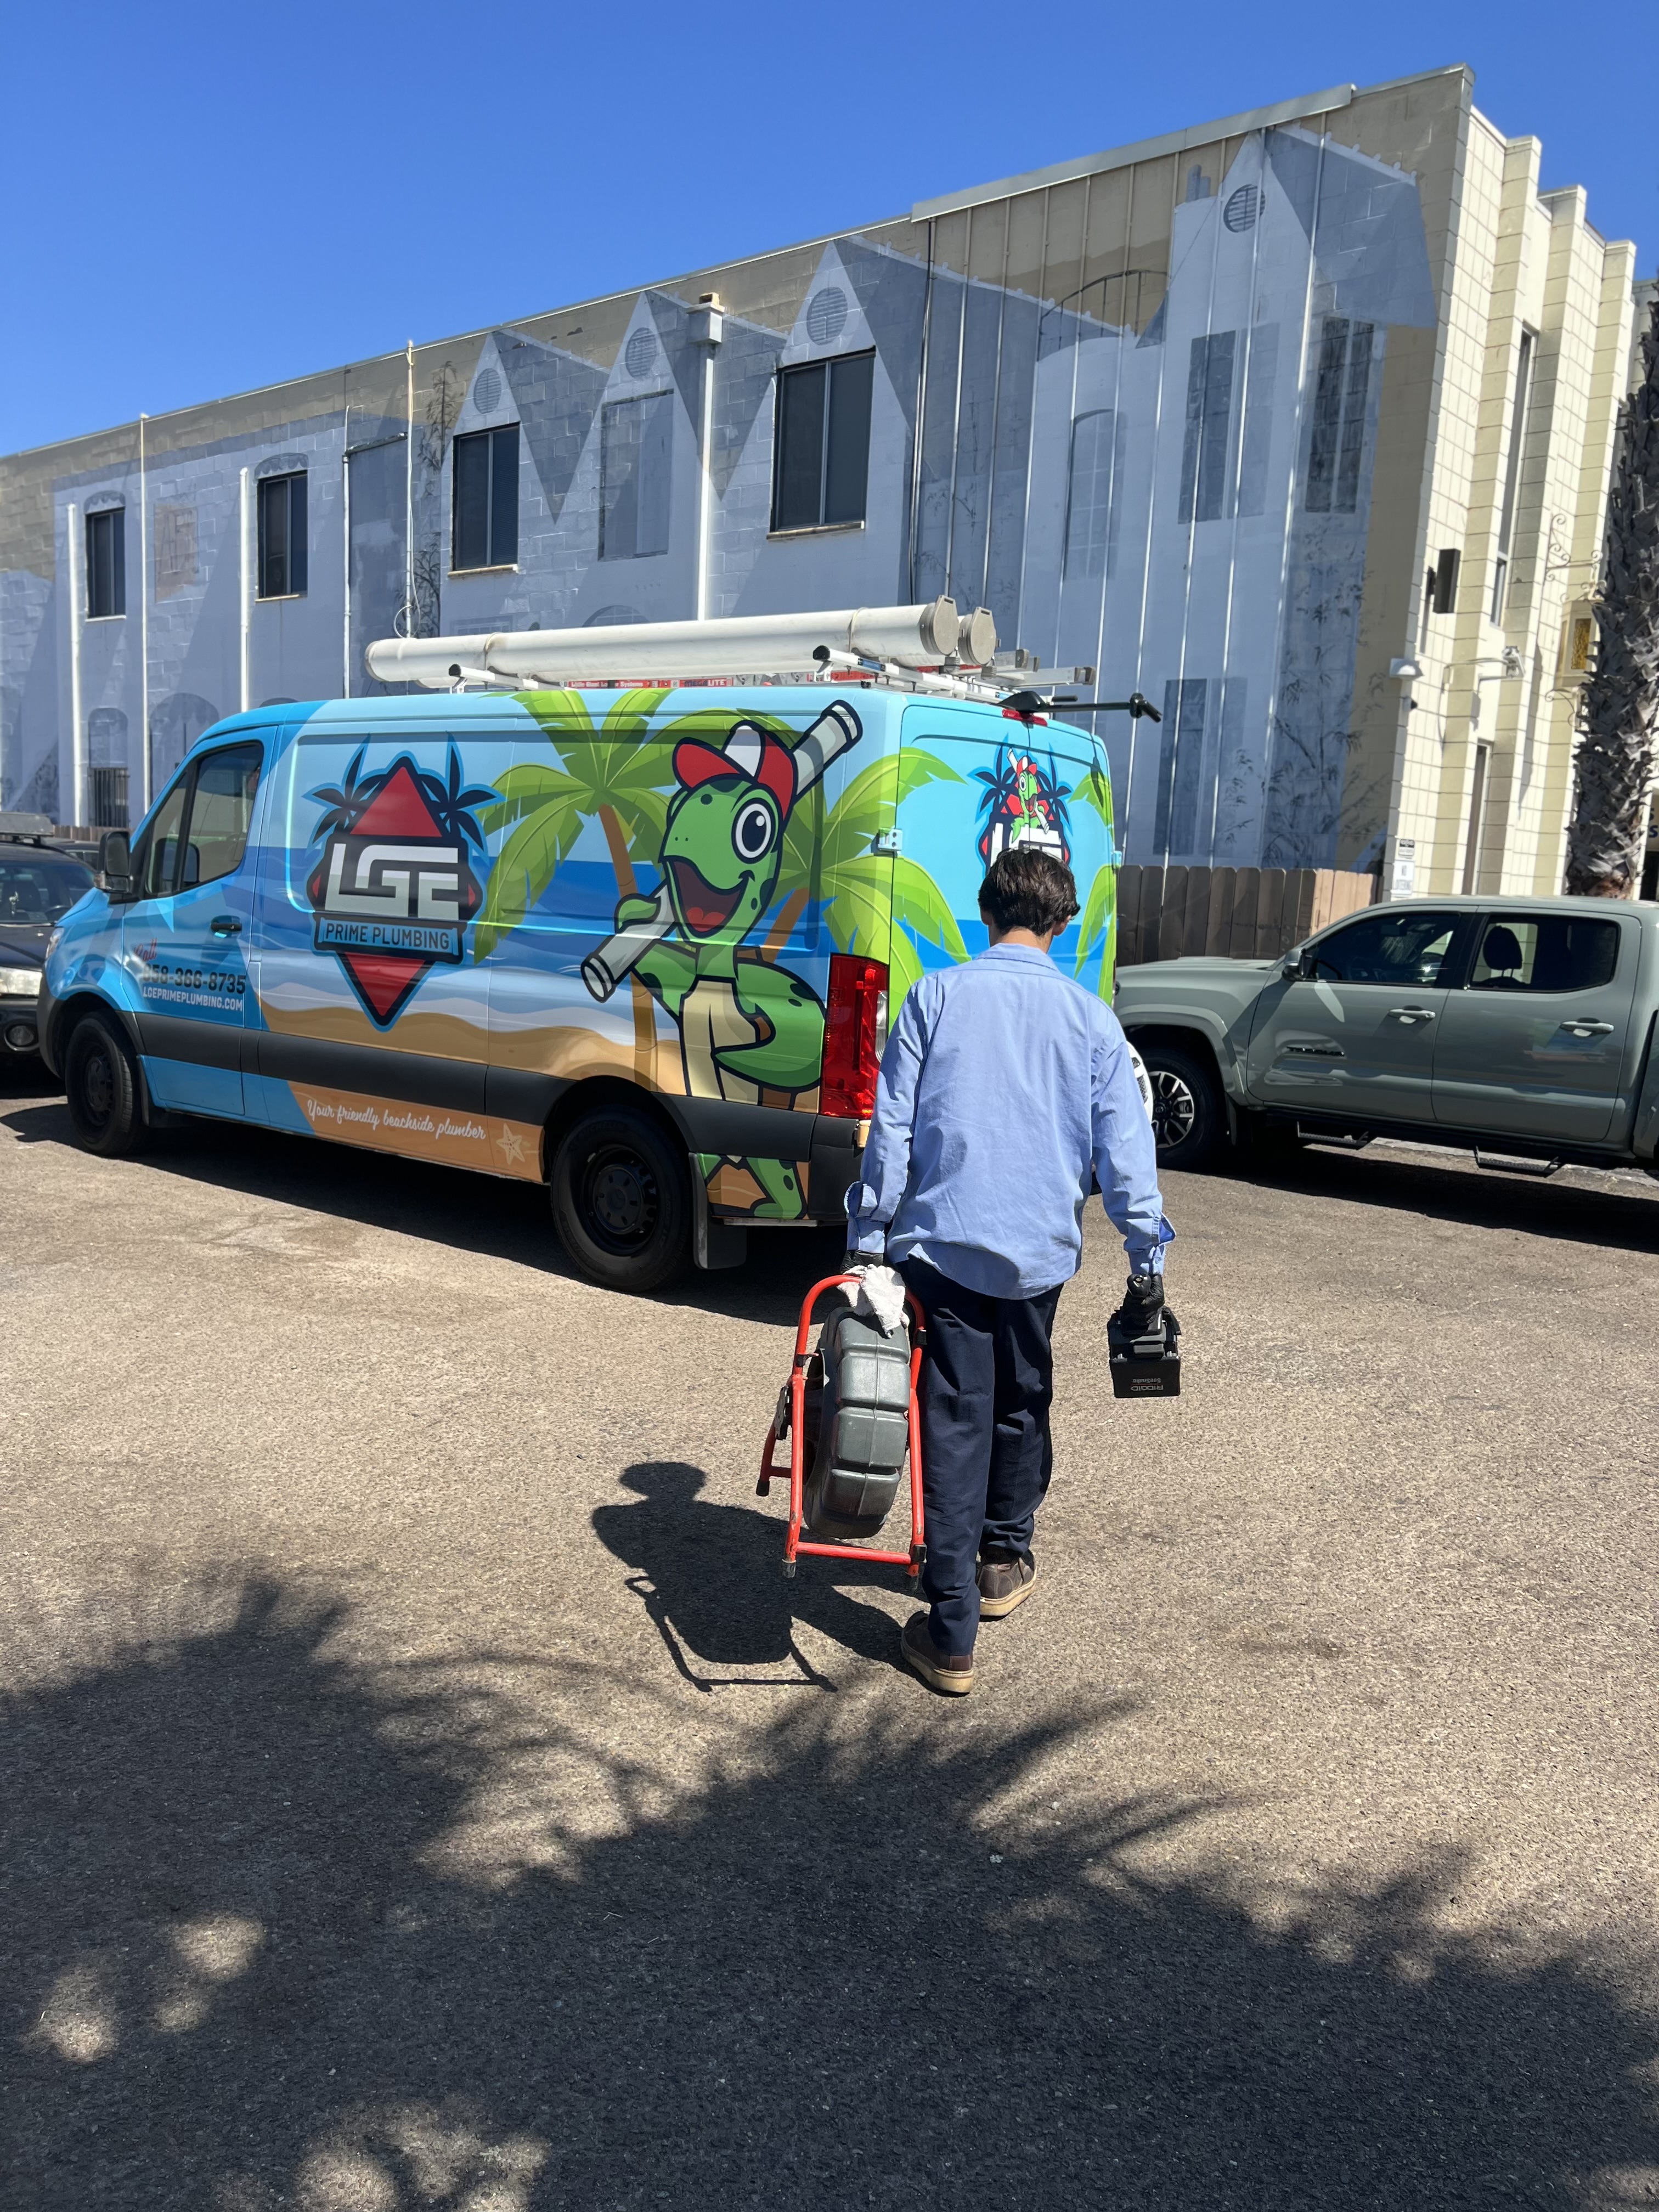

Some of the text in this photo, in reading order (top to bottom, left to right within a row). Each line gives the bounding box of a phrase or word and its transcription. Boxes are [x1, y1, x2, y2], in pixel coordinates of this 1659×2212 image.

[325, 843, 459, 921] LGE
[326, 923, 449, 950] PRIME PLUMBING
[307, 1099, 486, 1139] Your friendly beachside plumber
